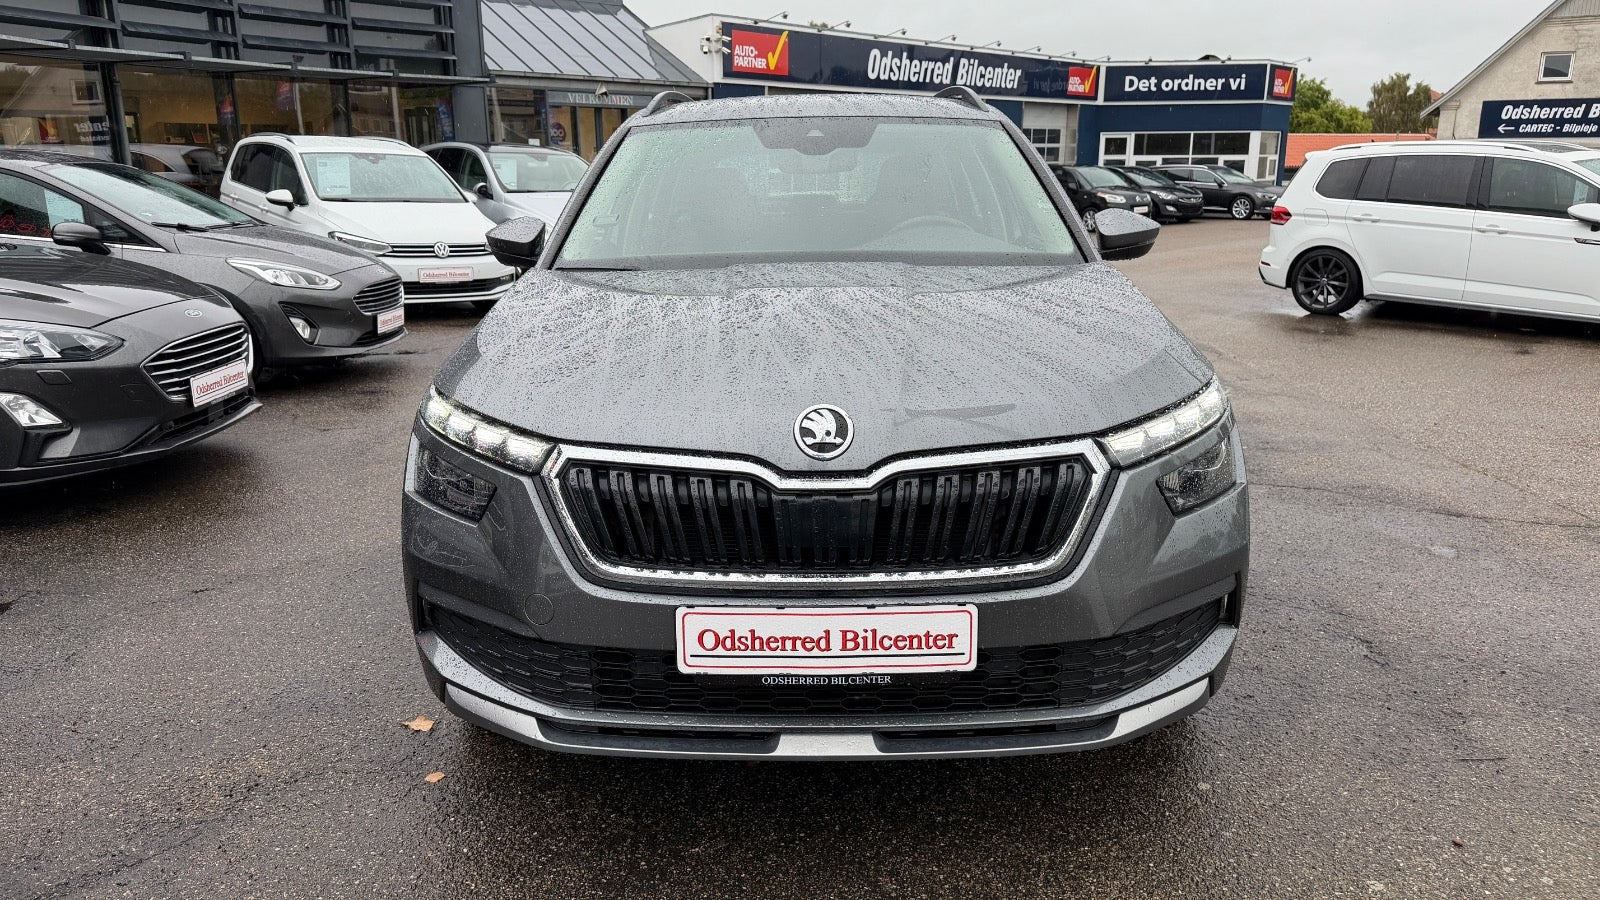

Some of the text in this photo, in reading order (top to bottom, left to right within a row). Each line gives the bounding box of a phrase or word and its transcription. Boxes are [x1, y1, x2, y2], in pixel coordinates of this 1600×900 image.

[734, 44, 758, 57] AUTO-
[734, 55, 767, 69] PARTNER
[867, 48, 954, 85] Odsherred
[956, 57, 1022, 89] Bilcenter
[1124, 73, 1246, 91] Det ordner vi
[567, 92, 634, 106] VELKOMMEN
[1501, 103, 1586, 120] Odsherred
[1518, 123, 1554, 133] CARTEC
[1562, 123, 1599, 134] Bilpleje
[697, 628, 958, 653] Odsherred Bilcenter
[762, 675, 892, 685] ODSHERRED BILCENTER
